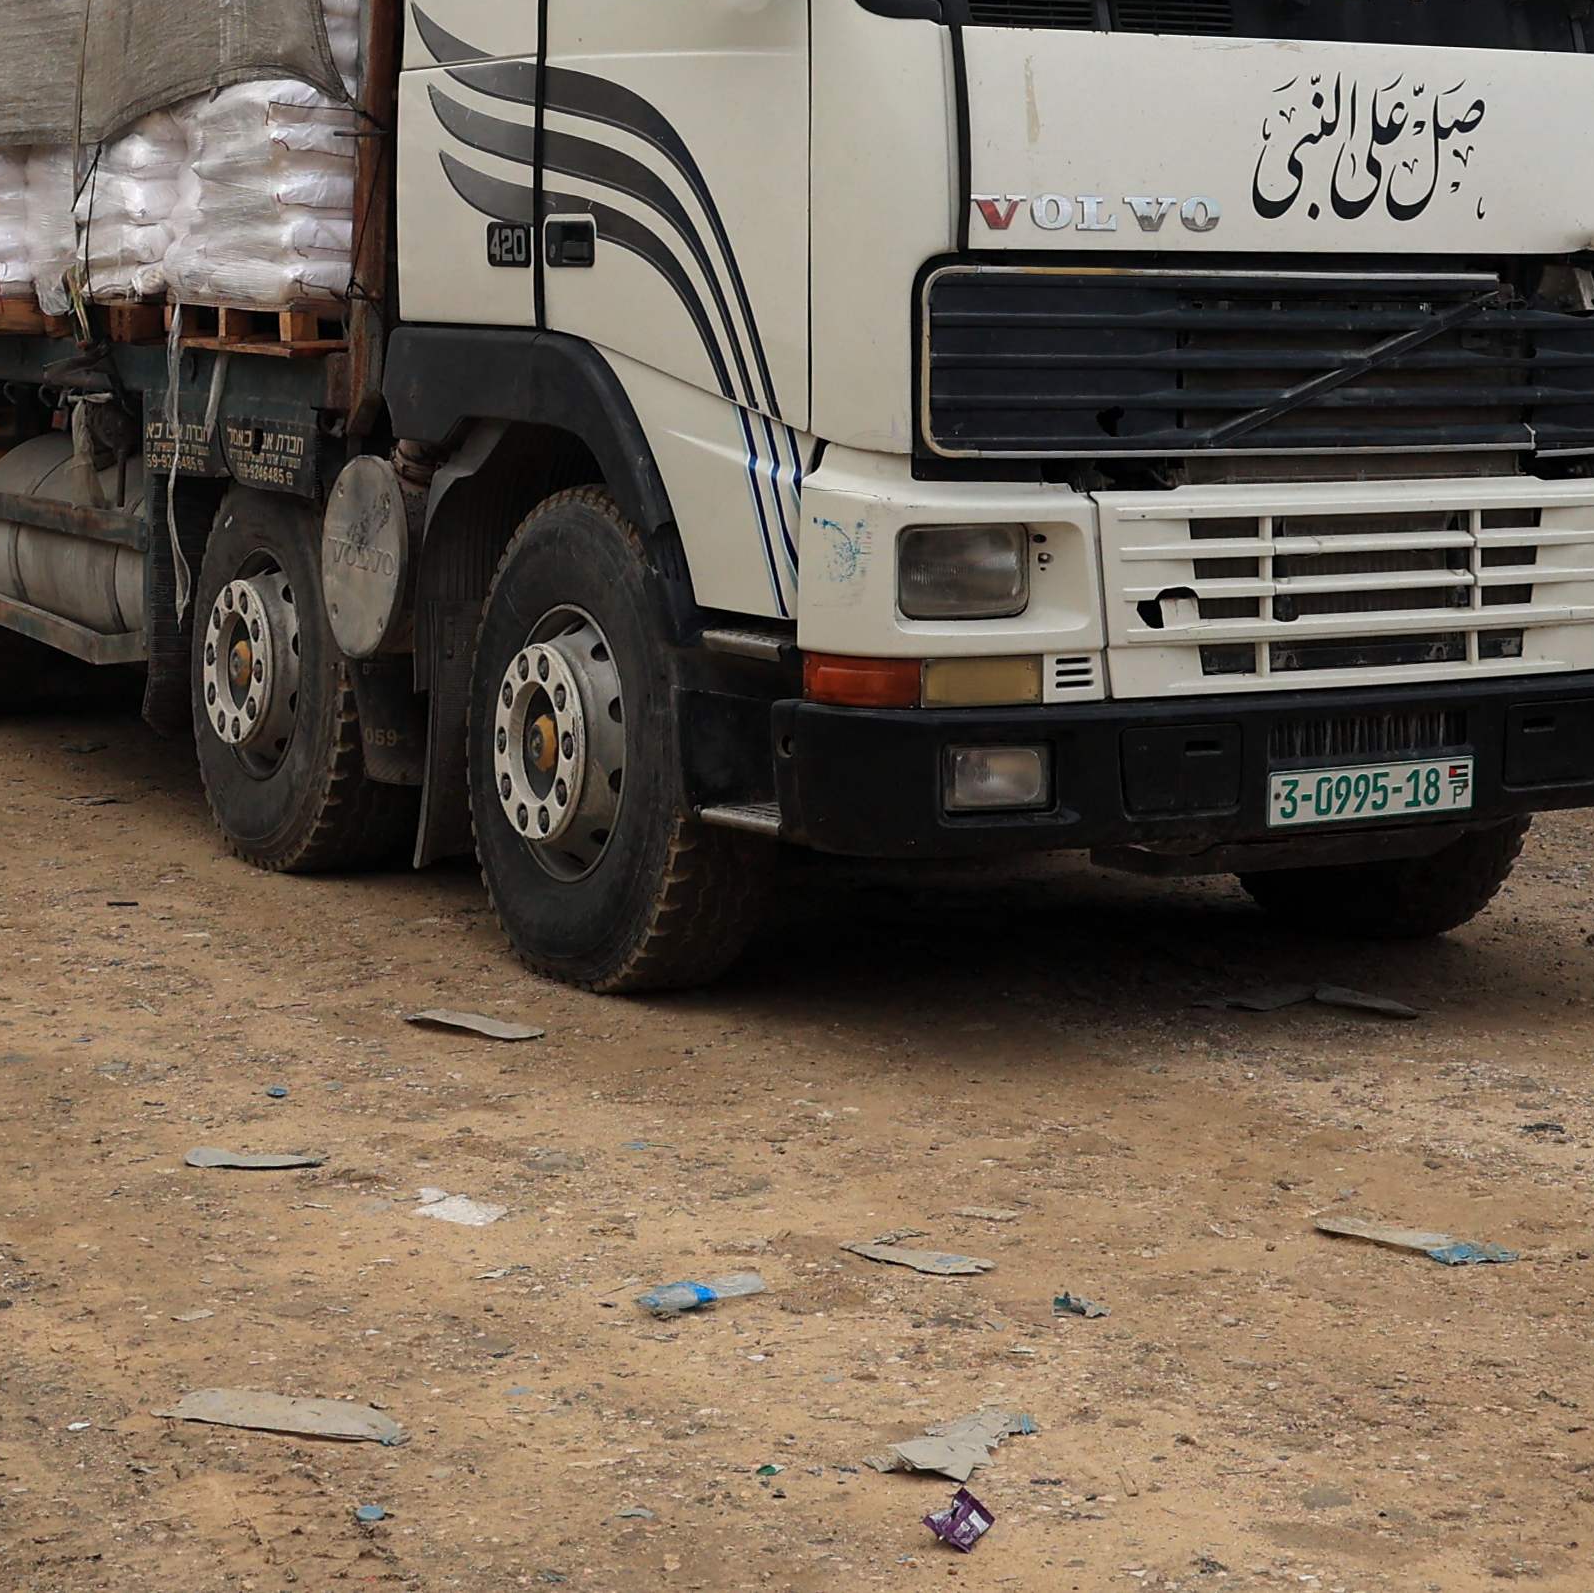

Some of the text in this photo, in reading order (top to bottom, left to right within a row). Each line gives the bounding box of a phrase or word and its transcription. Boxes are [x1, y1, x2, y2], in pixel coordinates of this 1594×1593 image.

[970, 194, 1222, 233] VOLVO
[489, 224, 527, 262] 420
[1280, 767, 1441, 819] 3-0995-18
